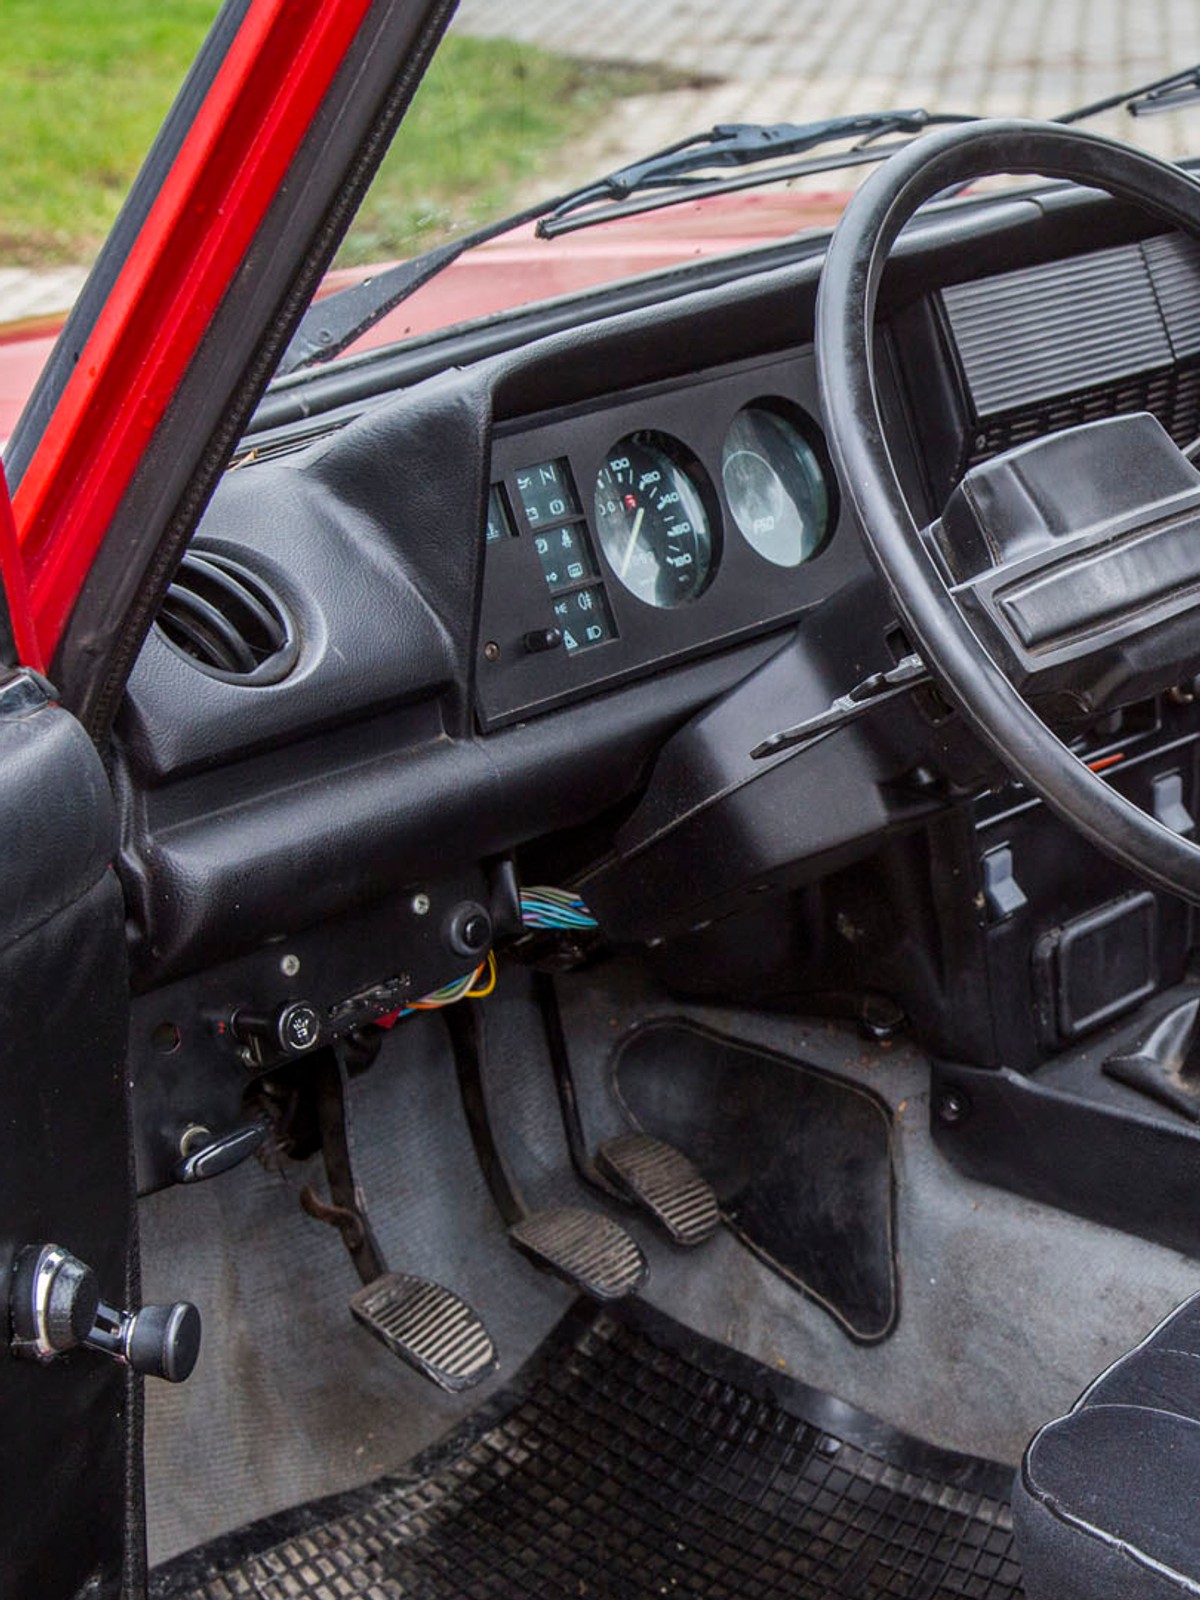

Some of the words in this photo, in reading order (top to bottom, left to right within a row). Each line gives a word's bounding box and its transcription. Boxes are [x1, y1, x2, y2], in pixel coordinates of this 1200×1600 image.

[610, 457, 630, 472] 100
[641, 470, 661, 485] 120
[659, 491, 680, 507] 140
[671, 522, 690, 537] 160
[753, 516, 775, 535] FSO
[673, 553, 693, 568] 180
